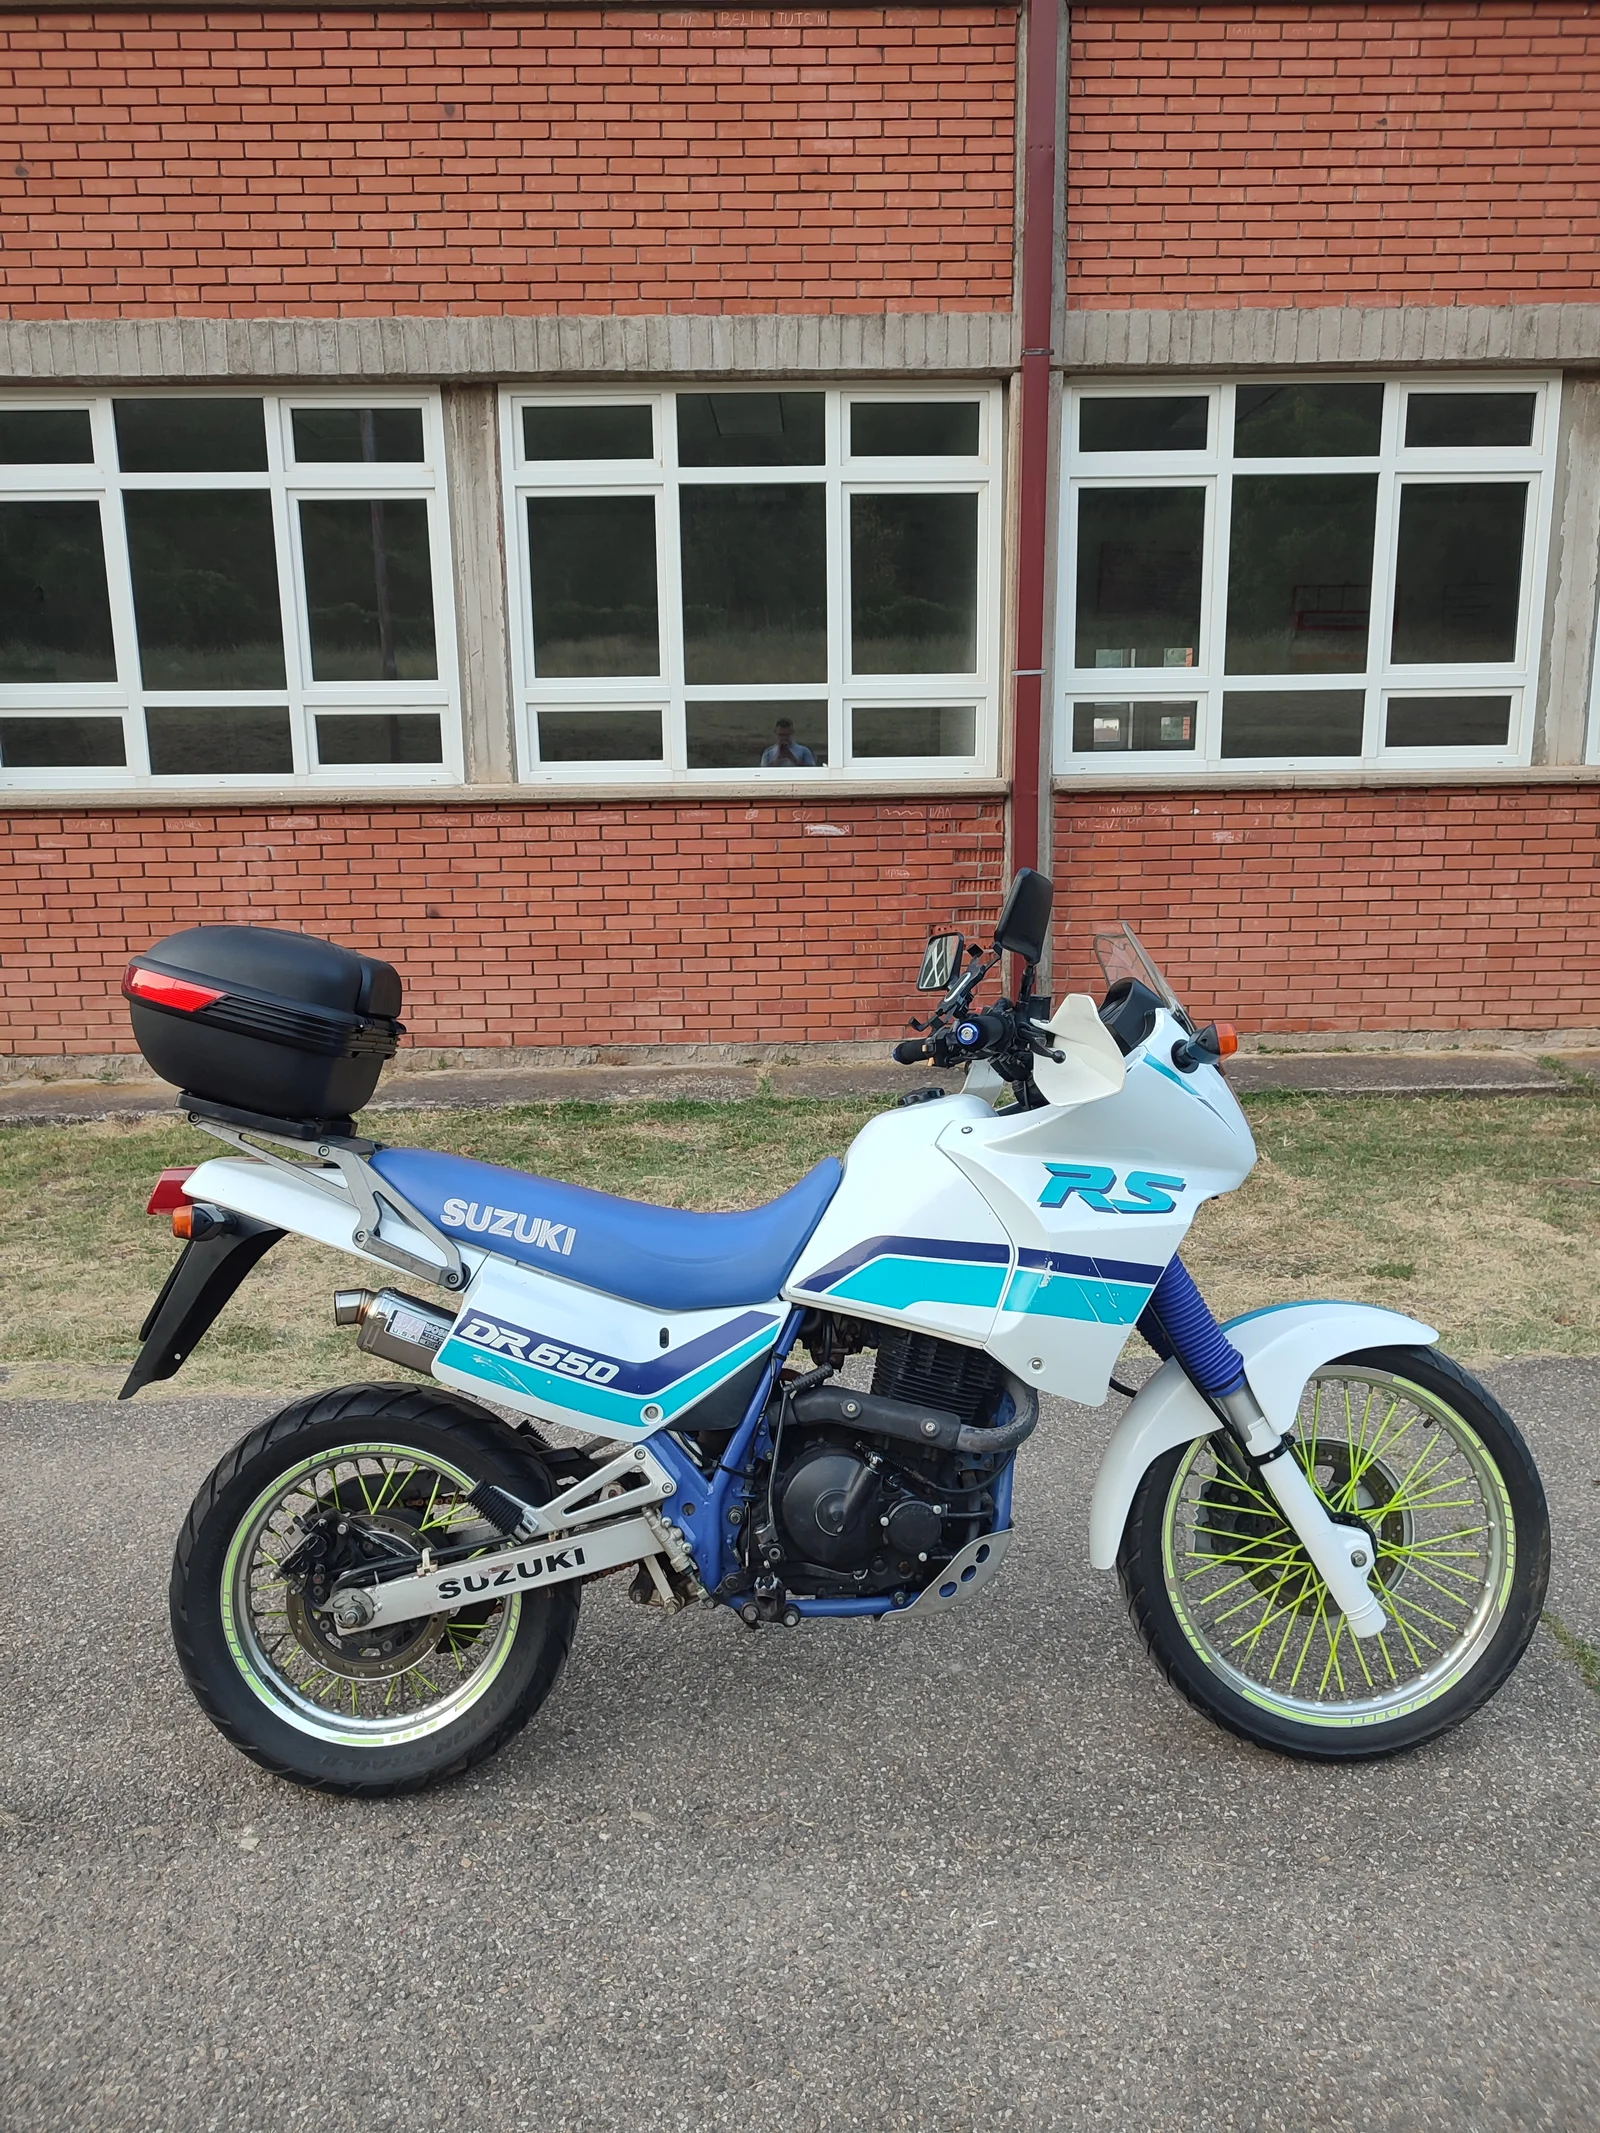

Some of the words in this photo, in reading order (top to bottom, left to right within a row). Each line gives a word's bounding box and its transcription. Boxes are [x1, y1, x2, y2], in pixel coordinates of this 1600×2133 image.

[1036, 1161, 1187, 1214] RS
[439, 1198, 577, 1256] SUZUKI
[459, 1317, 531, 1360] DR
[528, 1342, 620, 1384] 650
[438, 1547, 586, 1600] SUZUKI
